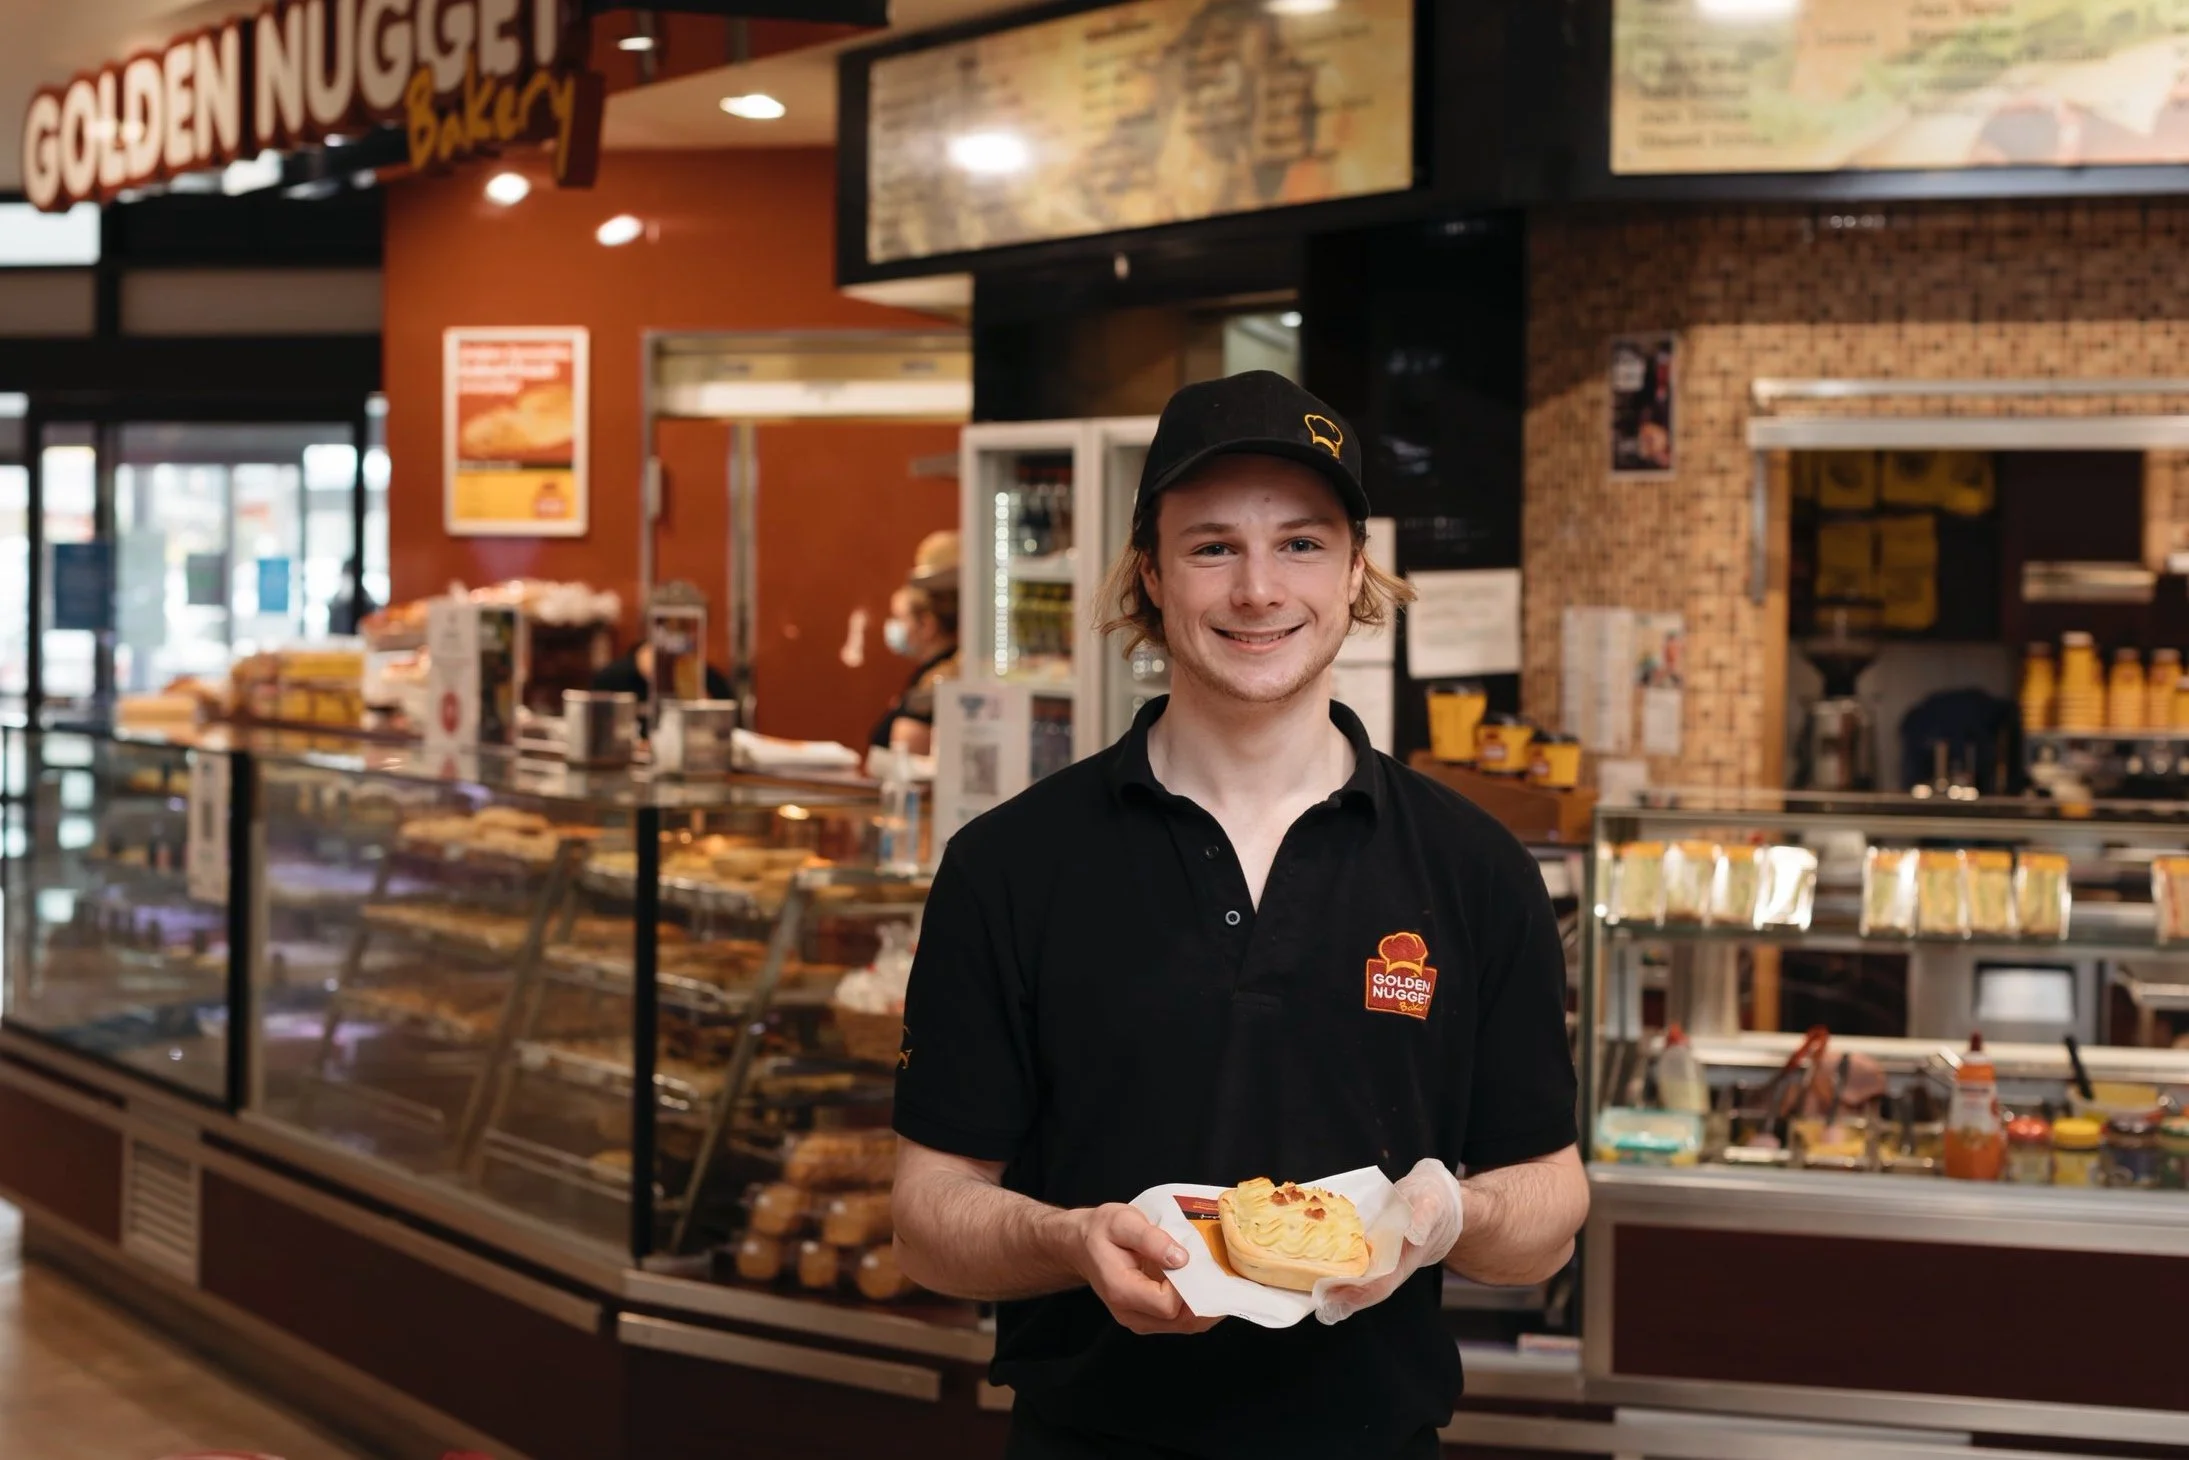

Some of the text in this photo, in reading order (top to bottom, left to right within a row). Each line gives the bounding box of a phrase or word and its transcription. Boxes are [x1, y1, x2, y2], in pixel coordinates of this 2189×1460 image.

[23, 25, 243, 208] GOLDEN
[404, 50, 576, 181] Bakery
[1373, 973, 1431, 993] GOLDEN
[1372, 985, 1431, 1005] NUGGET
[1399, 1001, 1428, 1013] Bake
